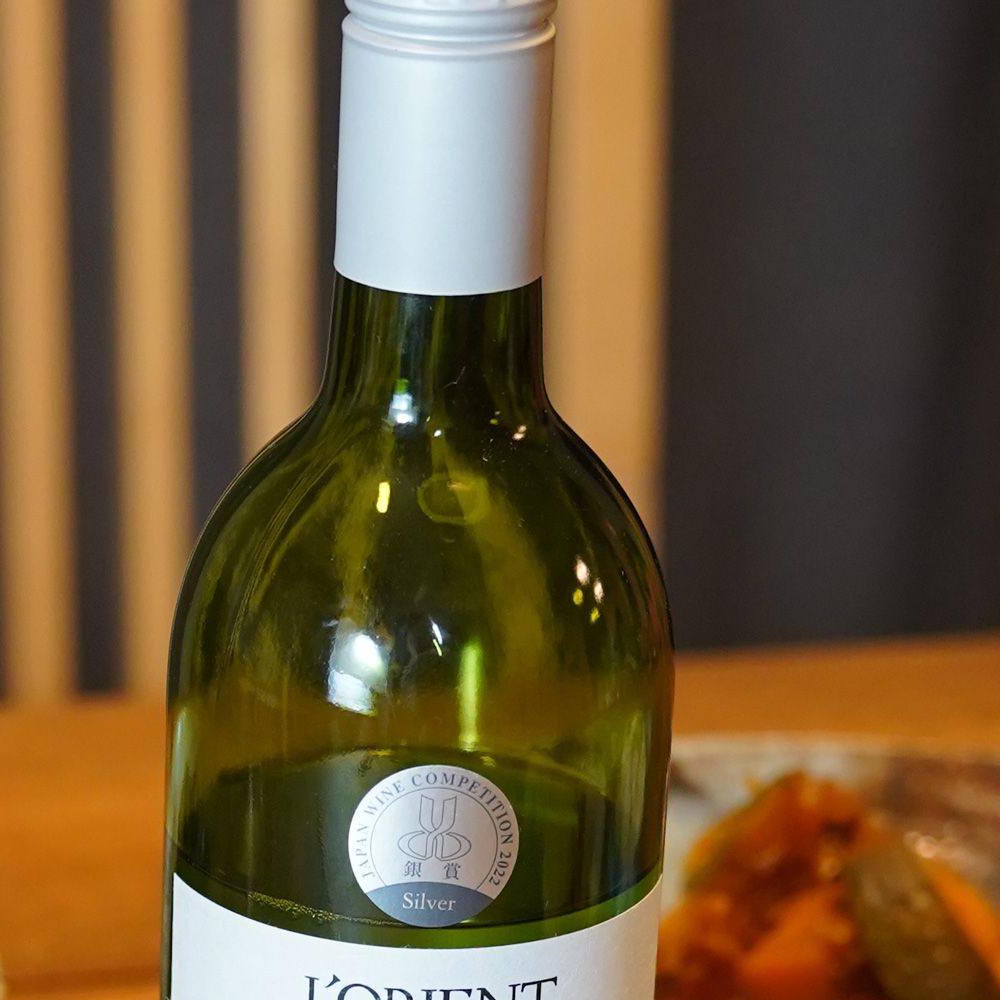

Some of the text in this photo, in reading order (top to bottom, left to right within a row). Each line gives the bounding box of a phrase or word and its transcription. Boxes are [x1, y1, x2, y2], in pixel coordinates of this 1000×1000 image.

[355, 771, 514, 886] JAPAN WINE COMPETITION 2022
[402, 892, 456, 911] Silver
